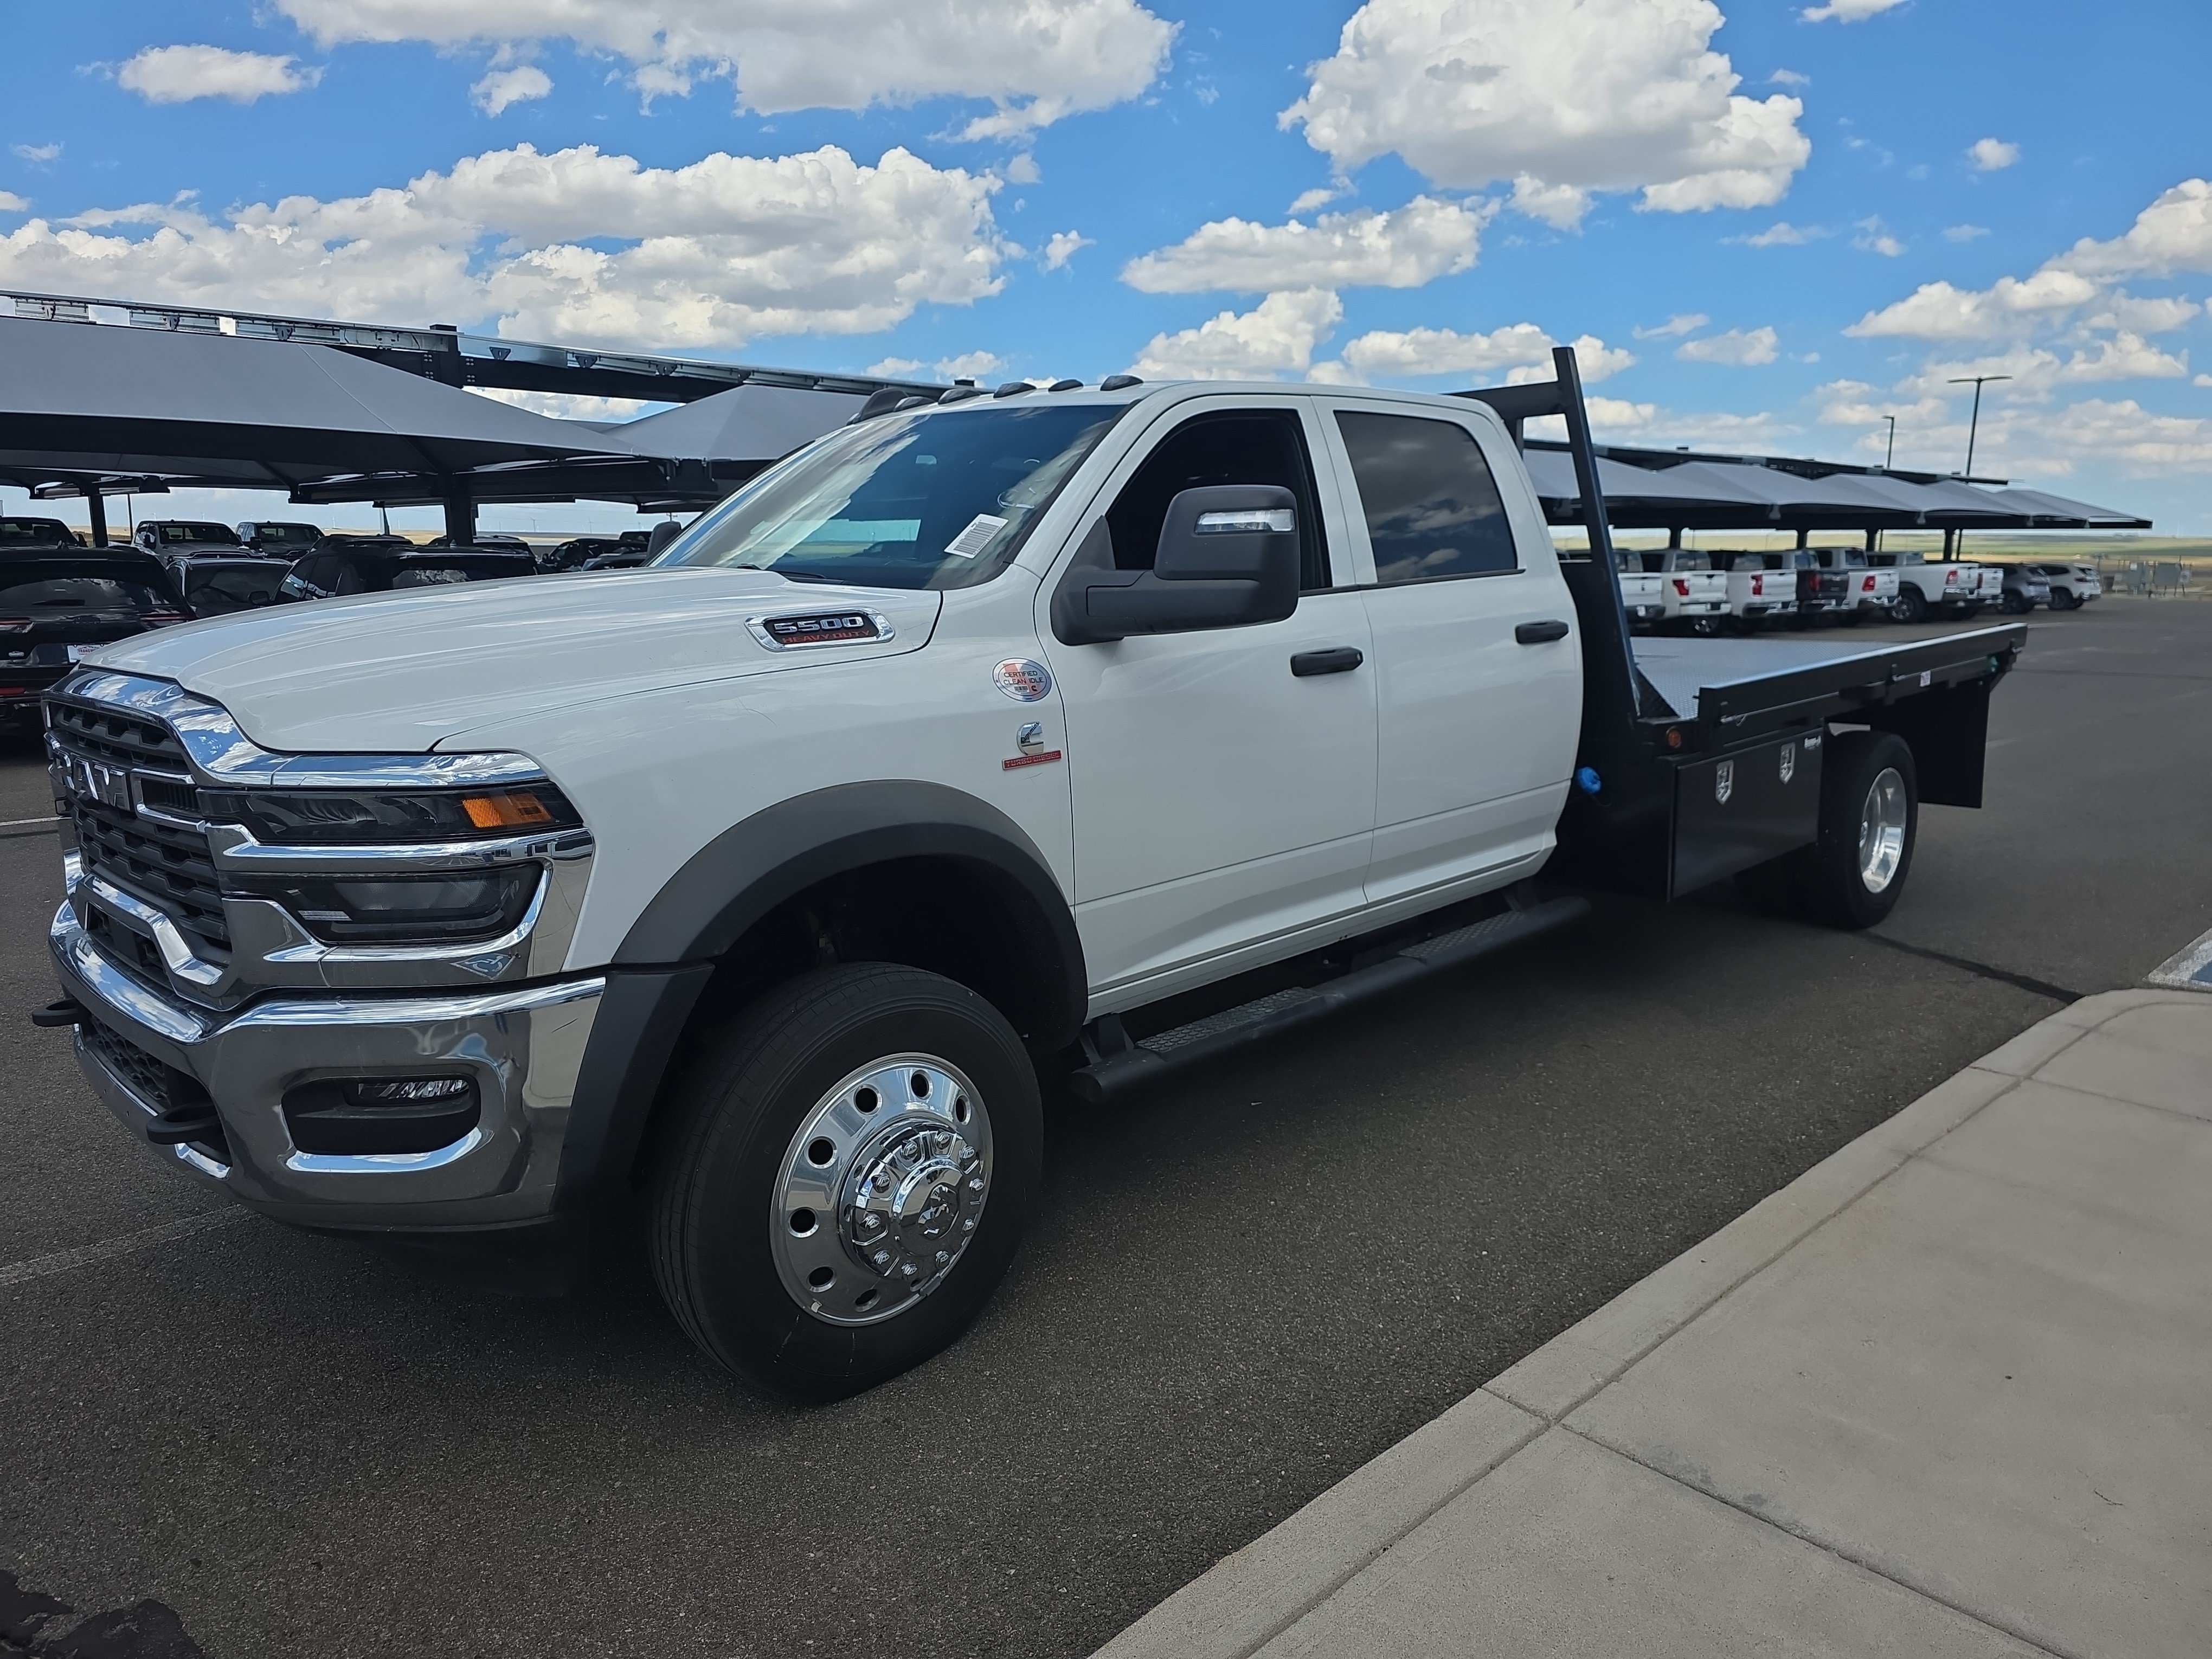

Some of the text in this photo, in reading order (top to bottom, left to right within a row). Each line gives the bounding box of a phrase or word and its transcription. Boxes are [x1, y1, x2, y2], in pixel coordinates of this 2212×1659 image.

[774, 616, 864, 634] 5500
[782, 630, 870, 644] HEAVY DUTY
[1021, 722, 1040, 744] Cummins
